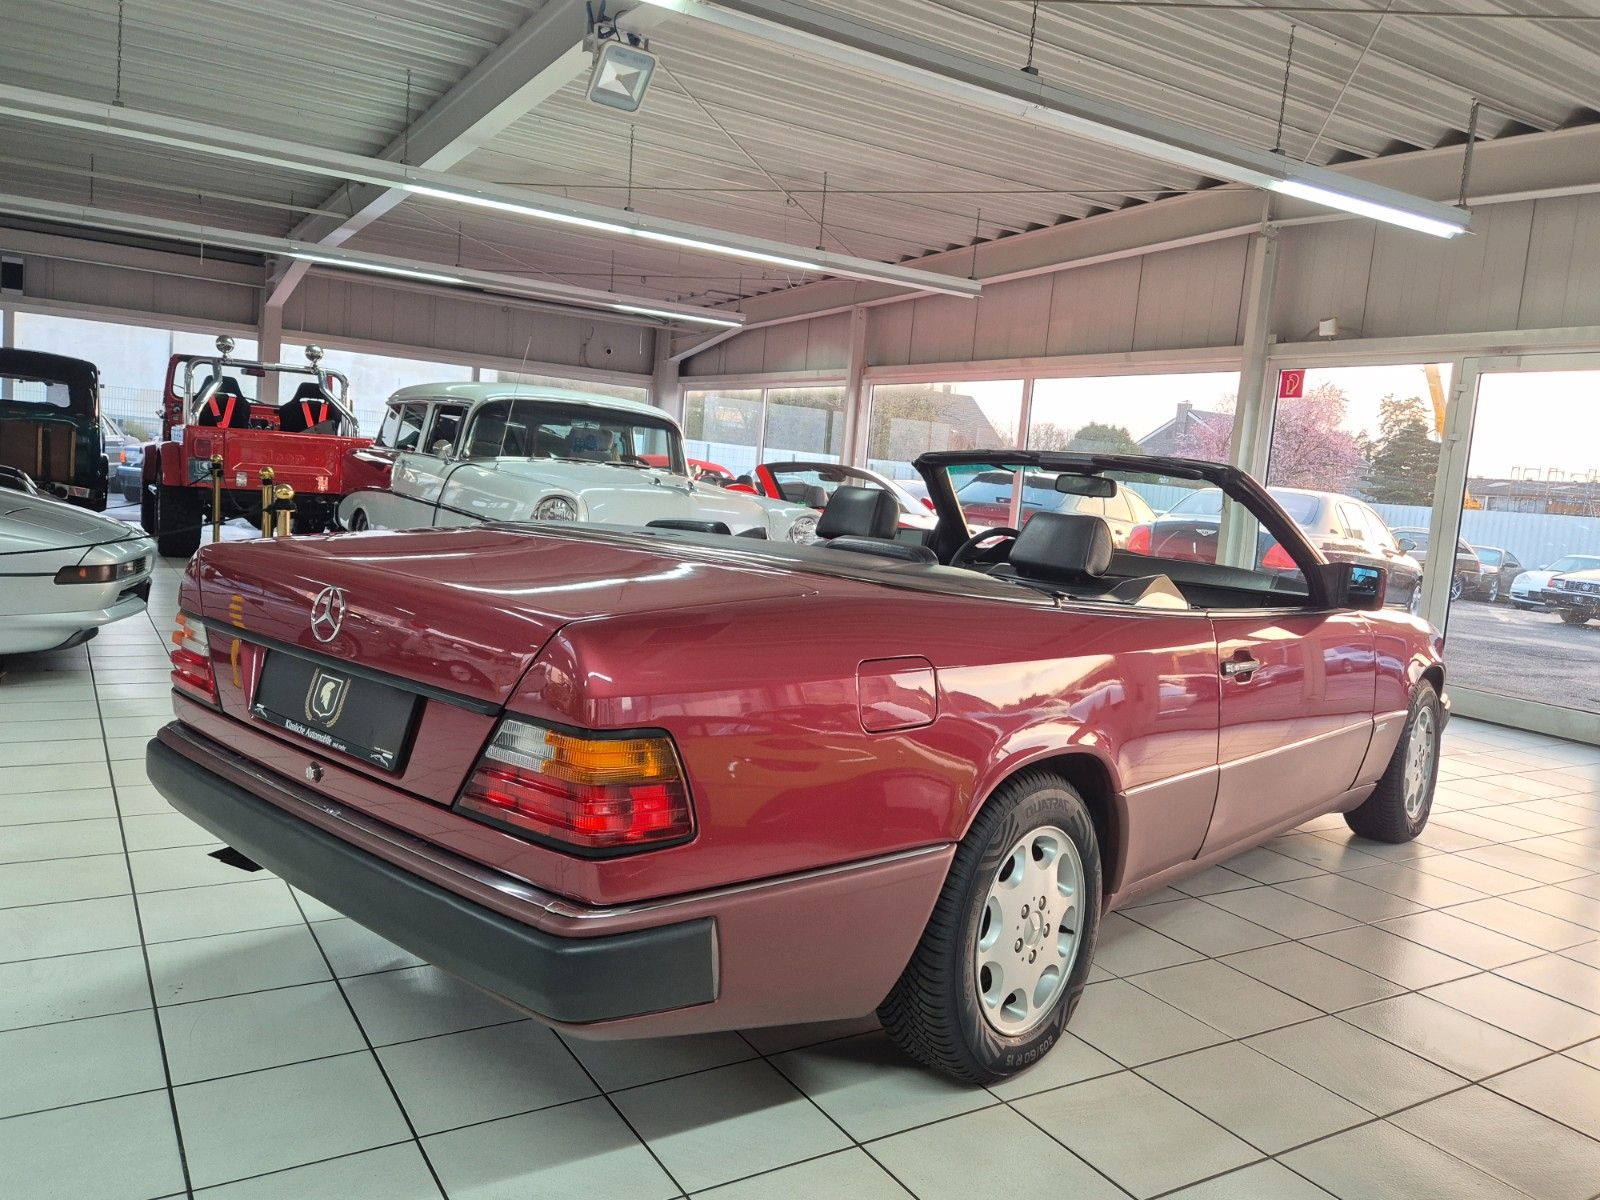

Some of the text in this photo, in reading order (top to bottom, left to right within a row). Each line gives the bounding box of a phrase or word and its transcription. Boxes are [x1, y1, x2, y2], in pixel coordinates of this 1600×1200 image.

[285, 719, 305, 734] Klassische
[305, 728, 332, 745] Automobile
[1006, 1035, 1053, 1066] 205/60 R 15
